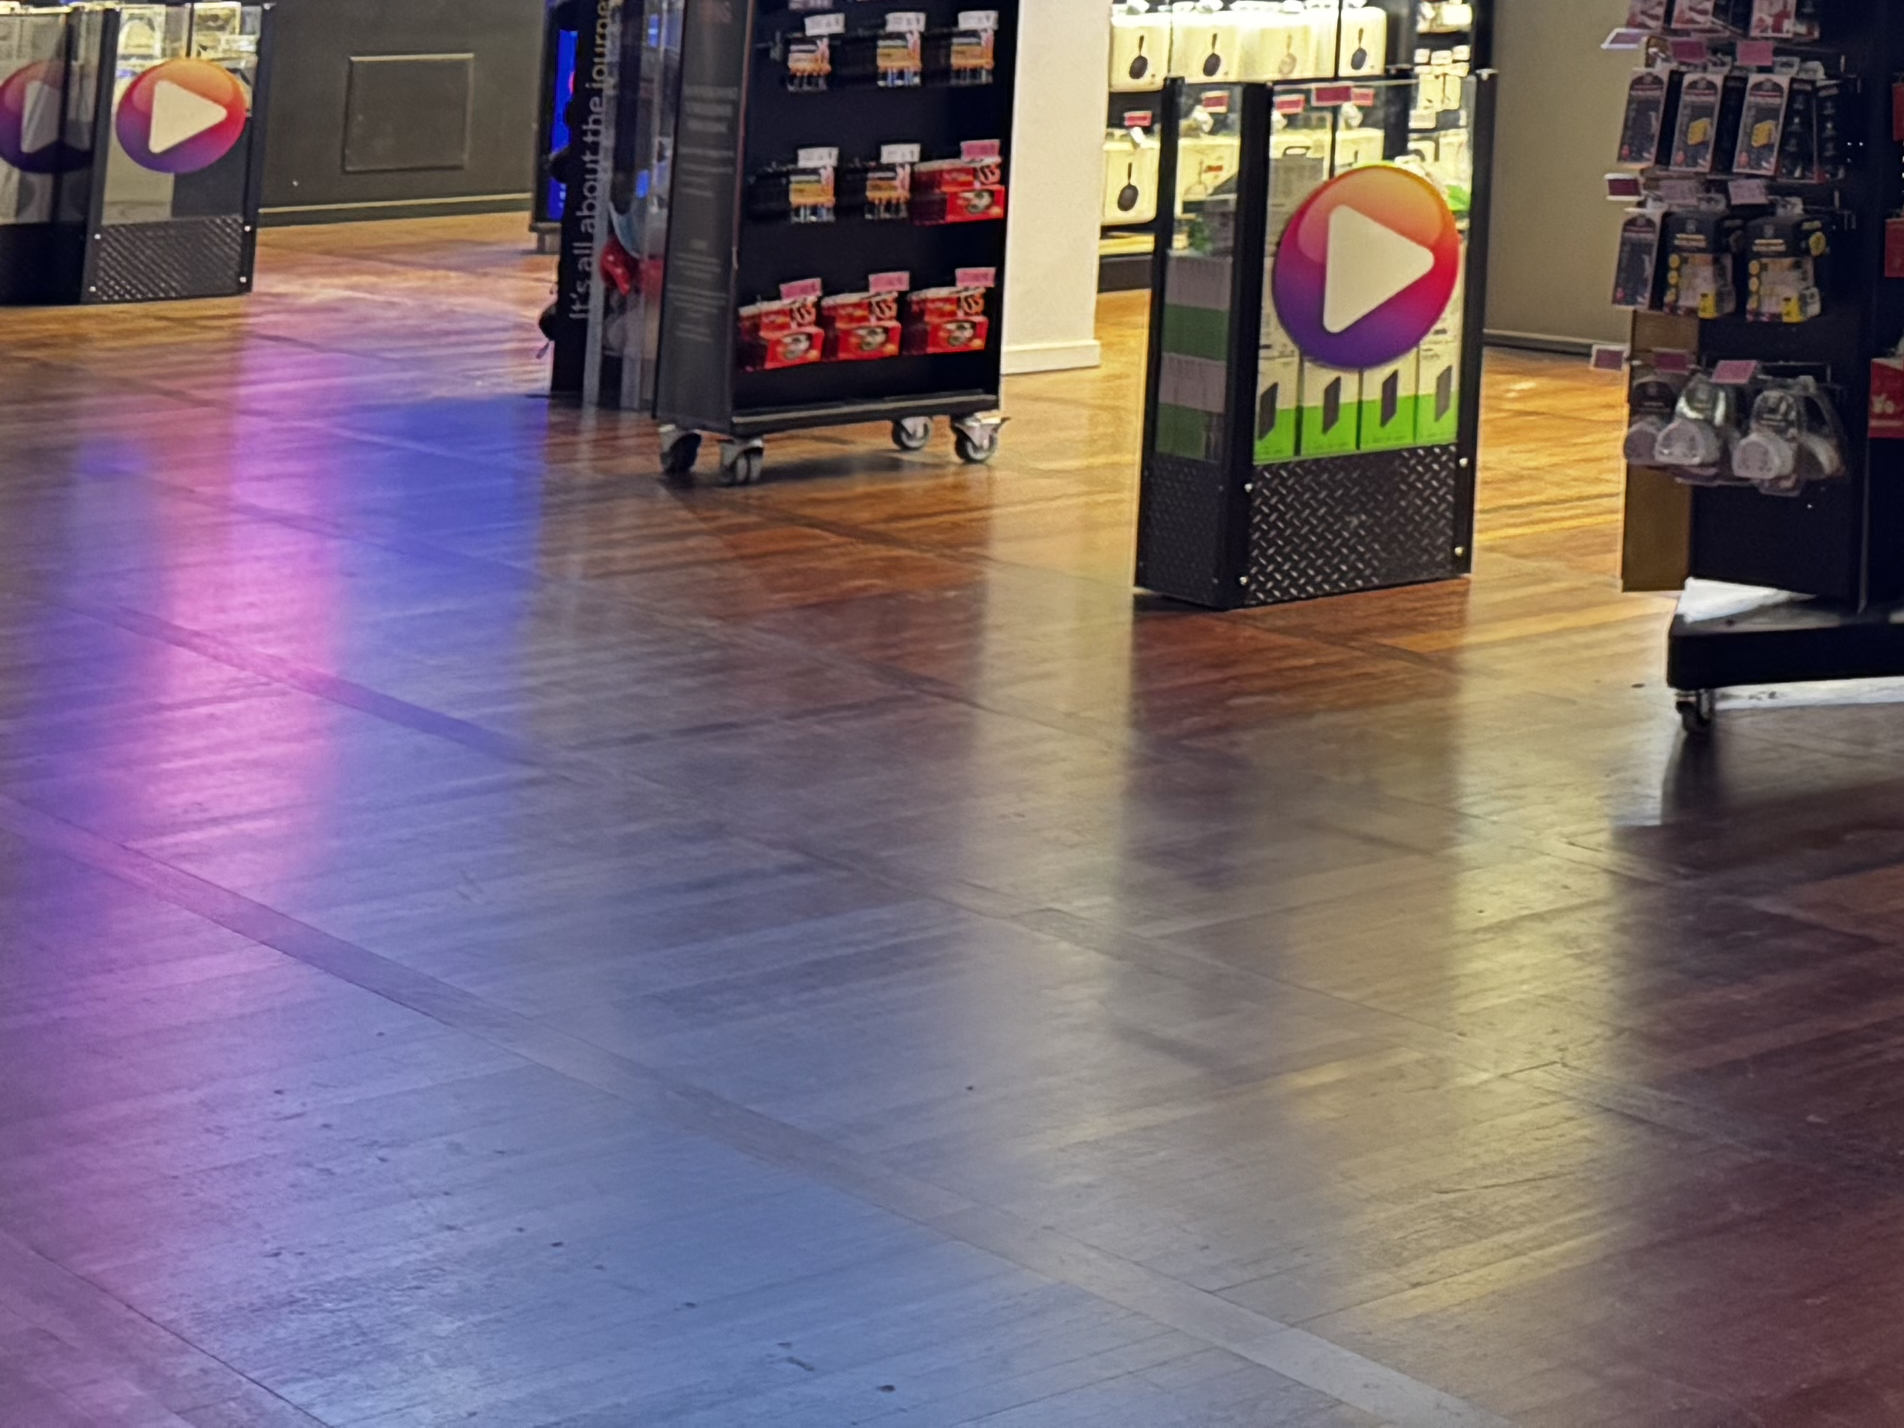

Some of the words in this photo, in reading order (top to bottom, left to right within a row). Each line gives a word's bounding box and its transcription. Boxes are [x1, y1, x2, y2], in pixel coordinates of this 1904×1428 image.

[582, 96, 605, 142] the
[575, 147, 602, 234] about
[573, 242, 593, 271] all
